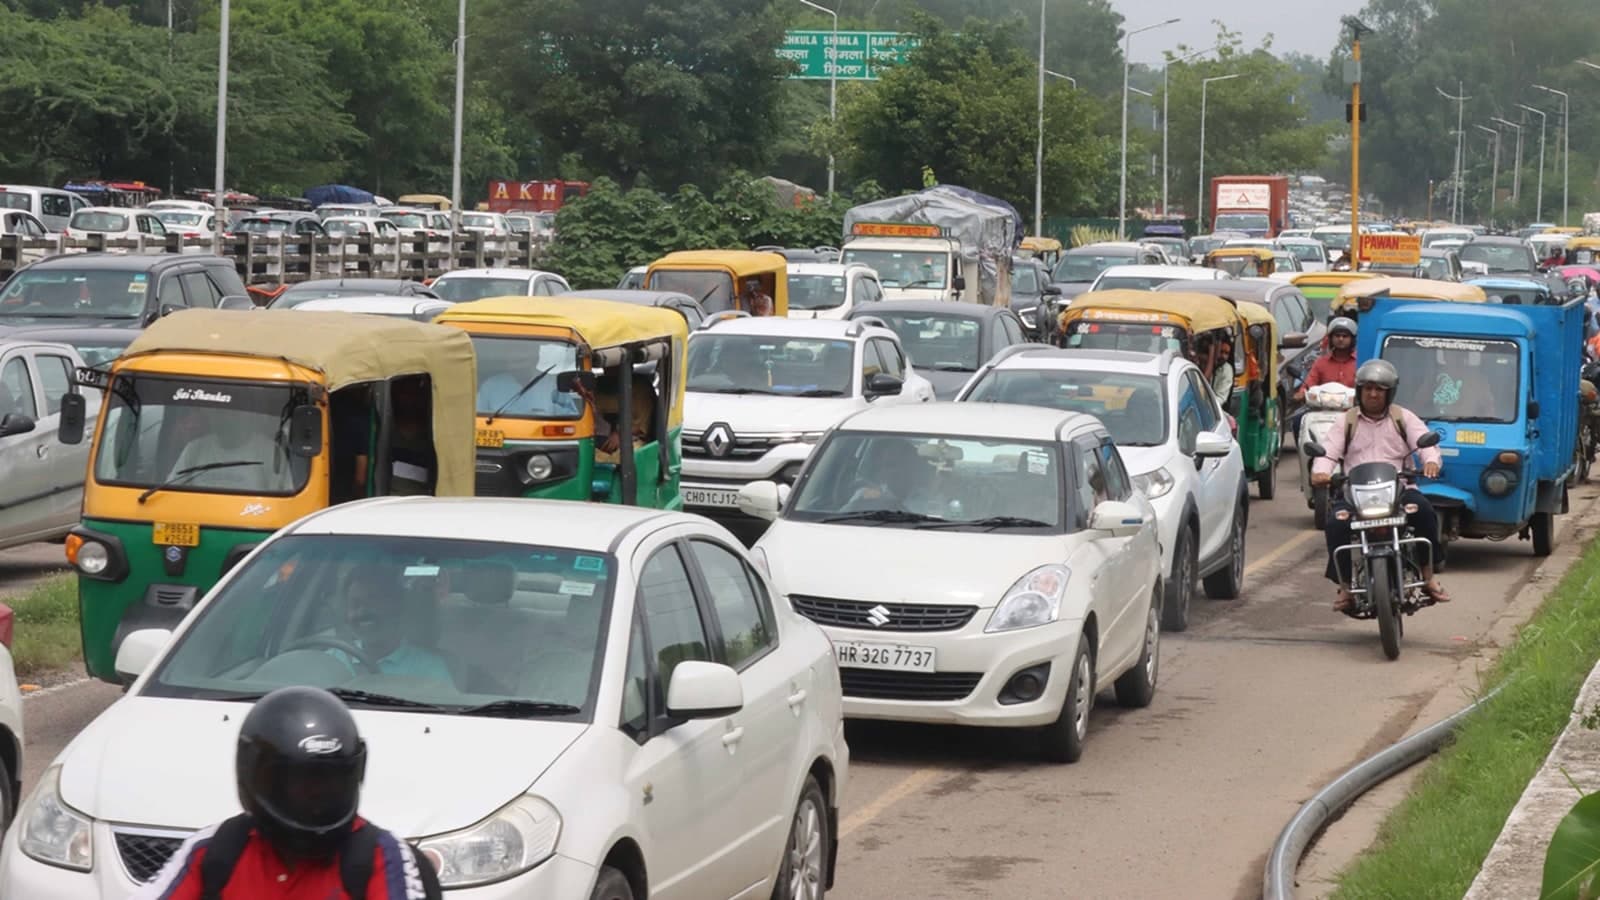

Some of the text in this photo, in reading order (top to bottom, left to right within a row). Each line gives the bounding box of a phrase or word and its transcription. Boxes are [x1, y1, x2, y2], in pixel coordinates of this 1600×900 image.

[823, 36, 859, 46] SHMLA
[1364, 235, 1399, 250] PAWAN
[839, 646, 932, 668] HR 32G 7737
